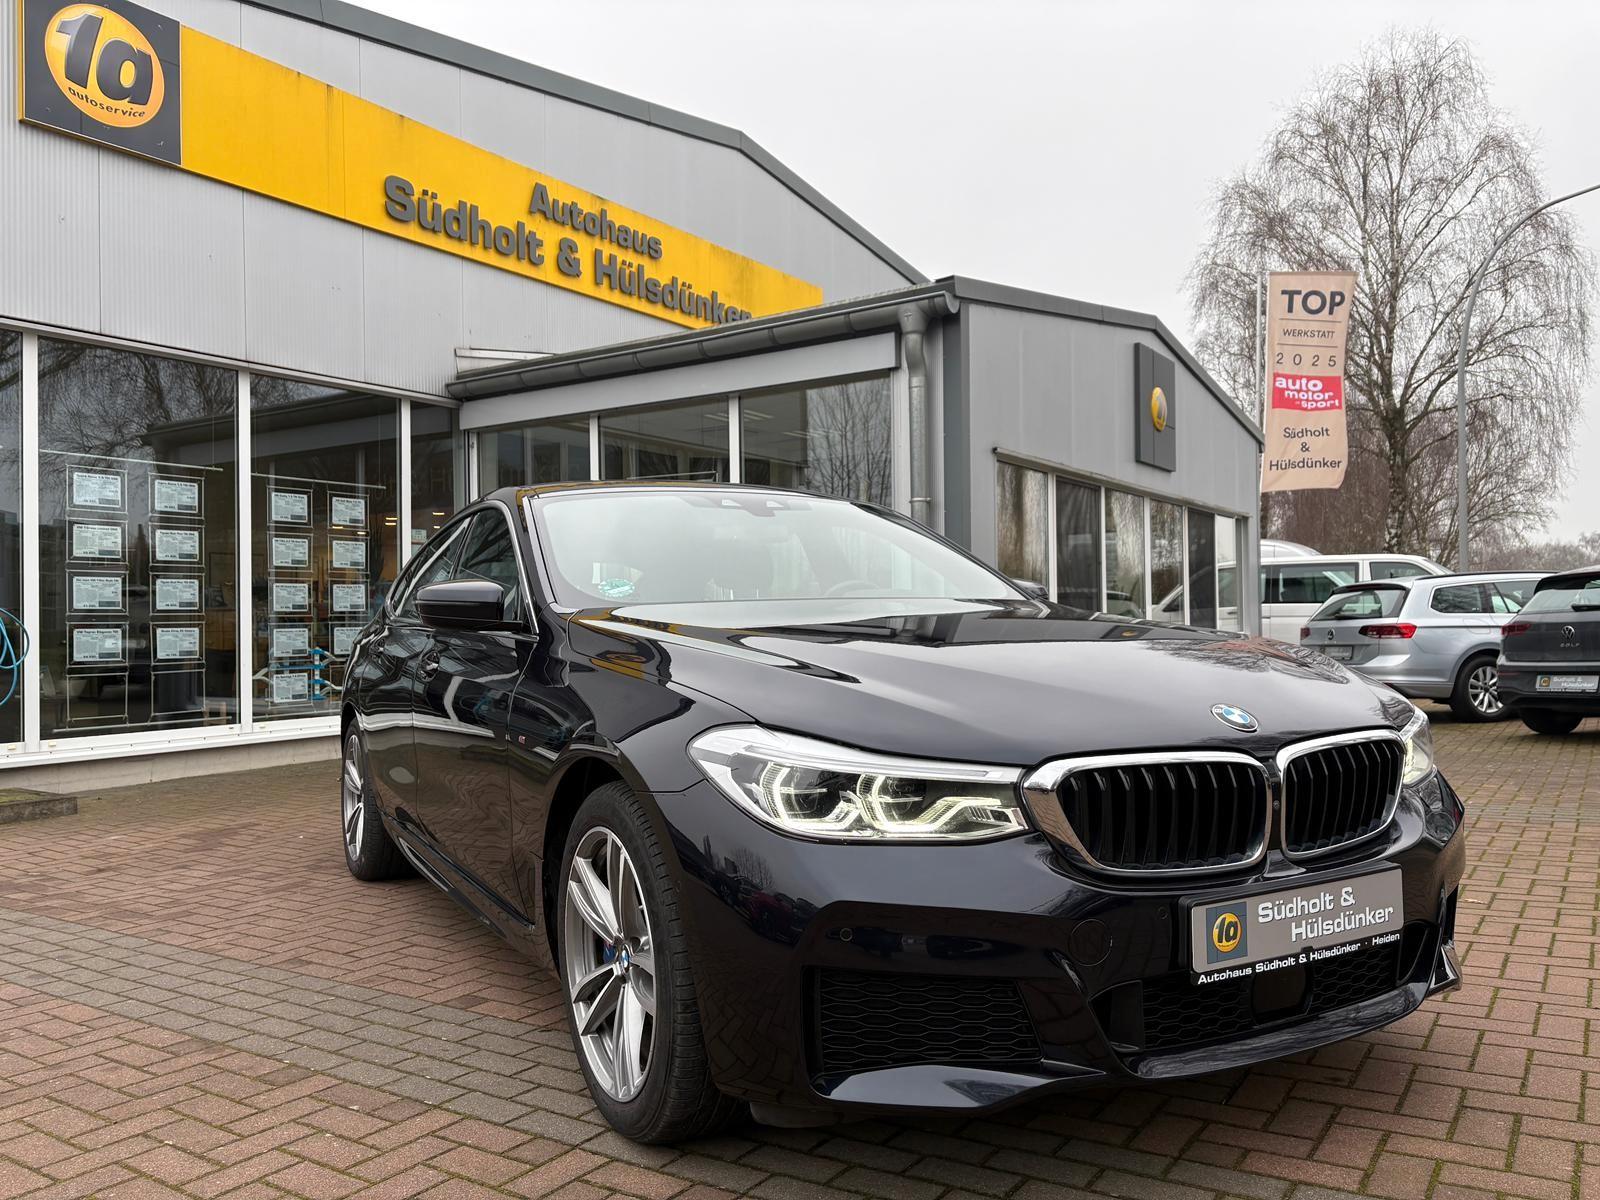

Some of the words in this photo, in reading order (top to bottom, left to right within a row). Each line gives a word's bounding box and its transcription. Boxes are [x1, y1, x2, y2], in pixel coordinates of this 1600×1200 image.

[56, 13, 154, 106] 1a
[67, 86, 147, 118] autoservice
[384, 175, 545, 265] Südholt
[557, 236, 582, 278] &
[529, 181, 662, 259] Autohaus
[1281, 289, 1346, 315] TOP
[1282, 328, 1336, 339] WERKSTATT
[1275, 377, 1323, 391] auto
[1284, 389, 1334, 401] motor
[1301, 399, 1340, 410] sport
[1283, 426, 1331, 439] Südholt
[1300, 441, 1311, 453] &
[1269, 457, 1343, 471] Hülsdünker
[1258, 892, 1334, 923] Südholt
[1341, 886, 1356, 907] &
[1215, 915, 1239, 944] 1a
[1291, 906, 1394, 942] Hülsdünker
[1197, 966, 1252, 985] Autohaus
[1255, 956, 1296, 973] Südholt
[1298, 953, 1308, 964] &
[1310, 943, 1361, 962] Hülsdünker
[1371, 933, 1400, 946] Heiden
